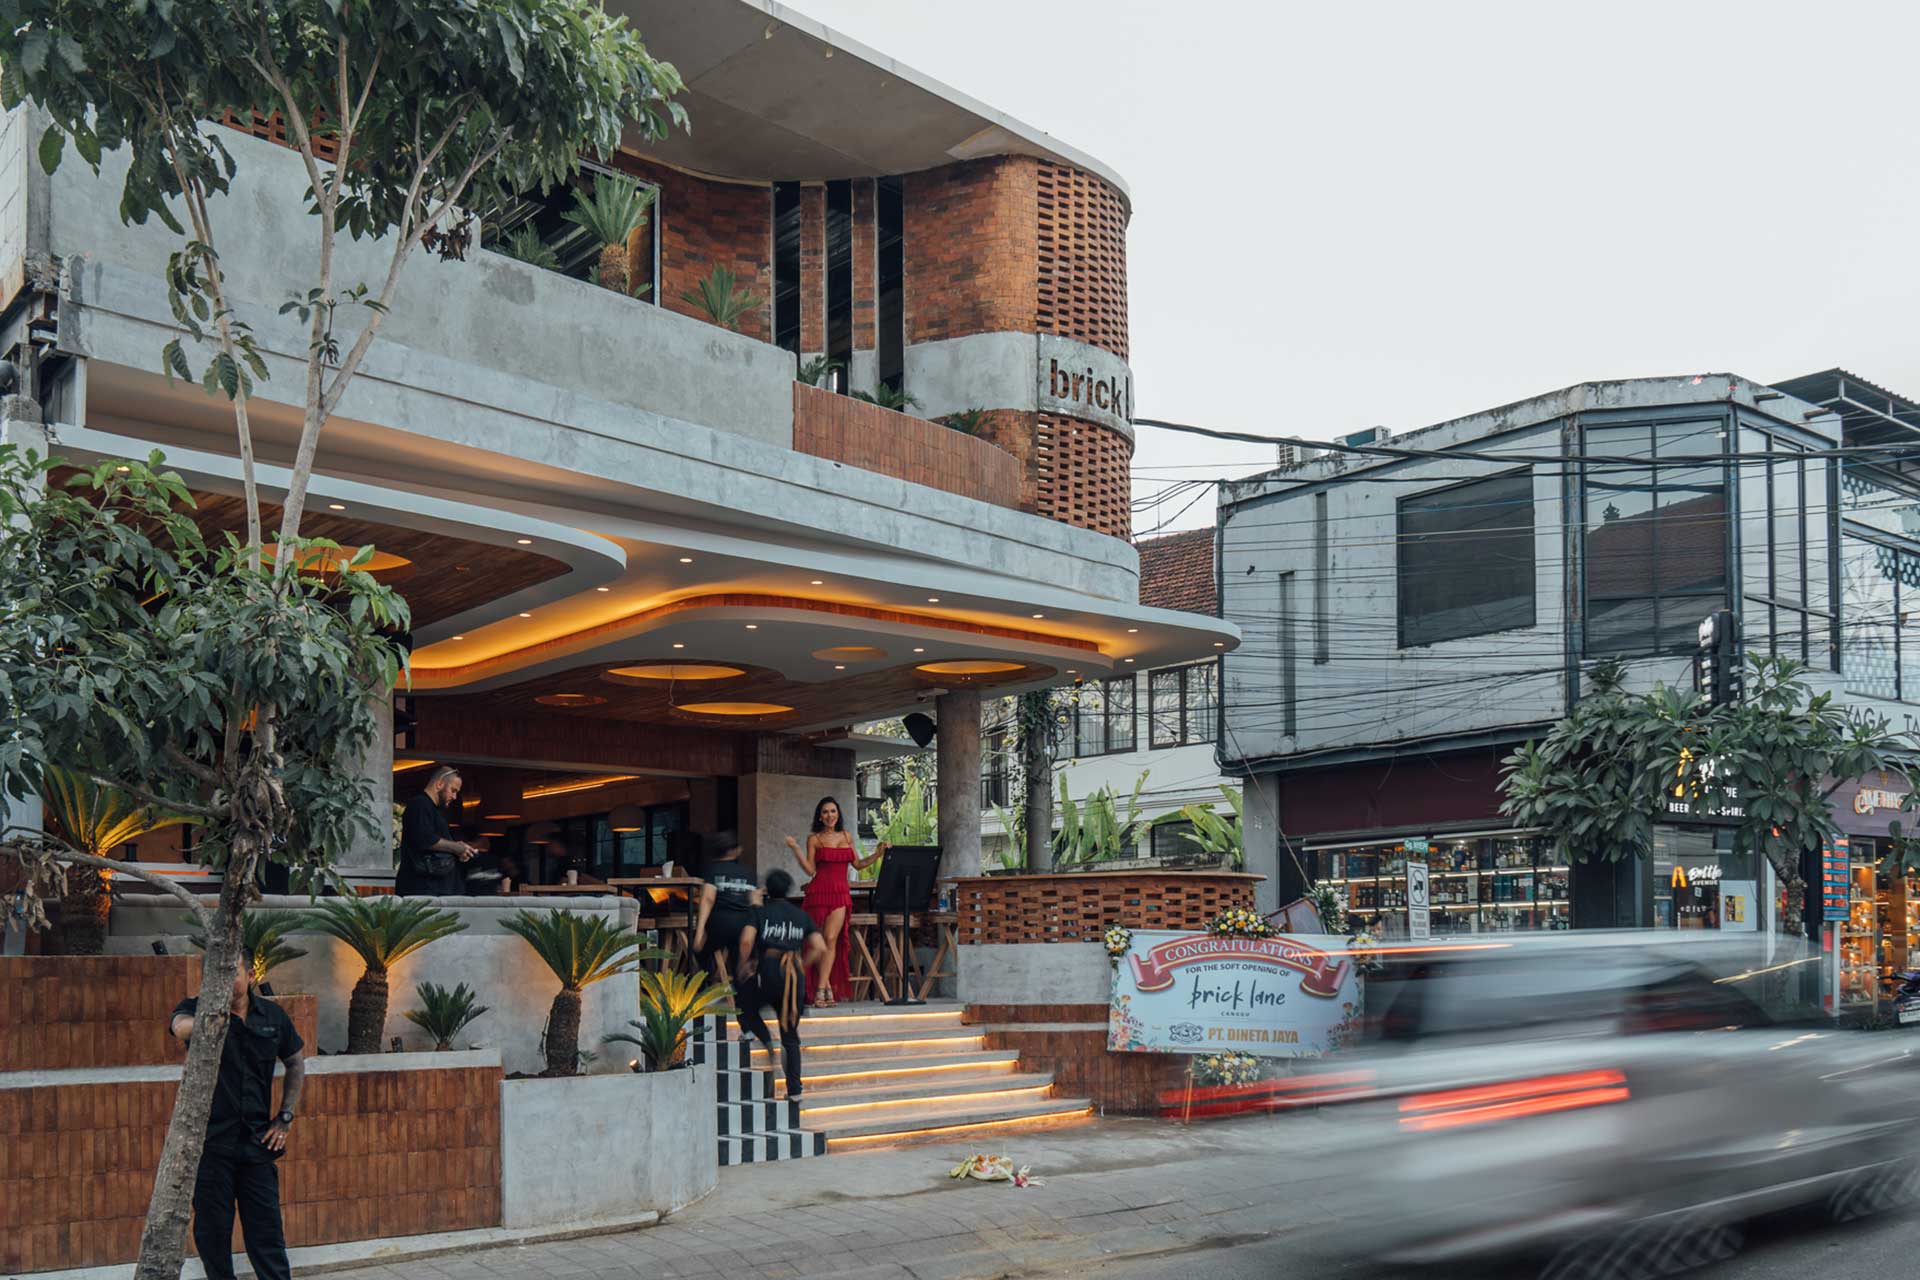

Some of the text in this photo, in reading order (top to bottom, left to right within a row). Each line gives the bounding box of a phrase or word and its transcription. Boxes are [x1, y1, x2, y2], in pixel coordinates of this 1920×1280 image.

[1669, 802, 1690, 813] BEER
[1687, 865, 1723, 881] Bottle
[1164, 939, 1316, 967] CONGRATULATIONS
[1185, 962, 1291, 977] FOR THE SOFT OPENING OF
[1187, 974, 1286, 1010] brick lane
[1207, 1027, 1299, 1043] PT. DINETA JAYA
